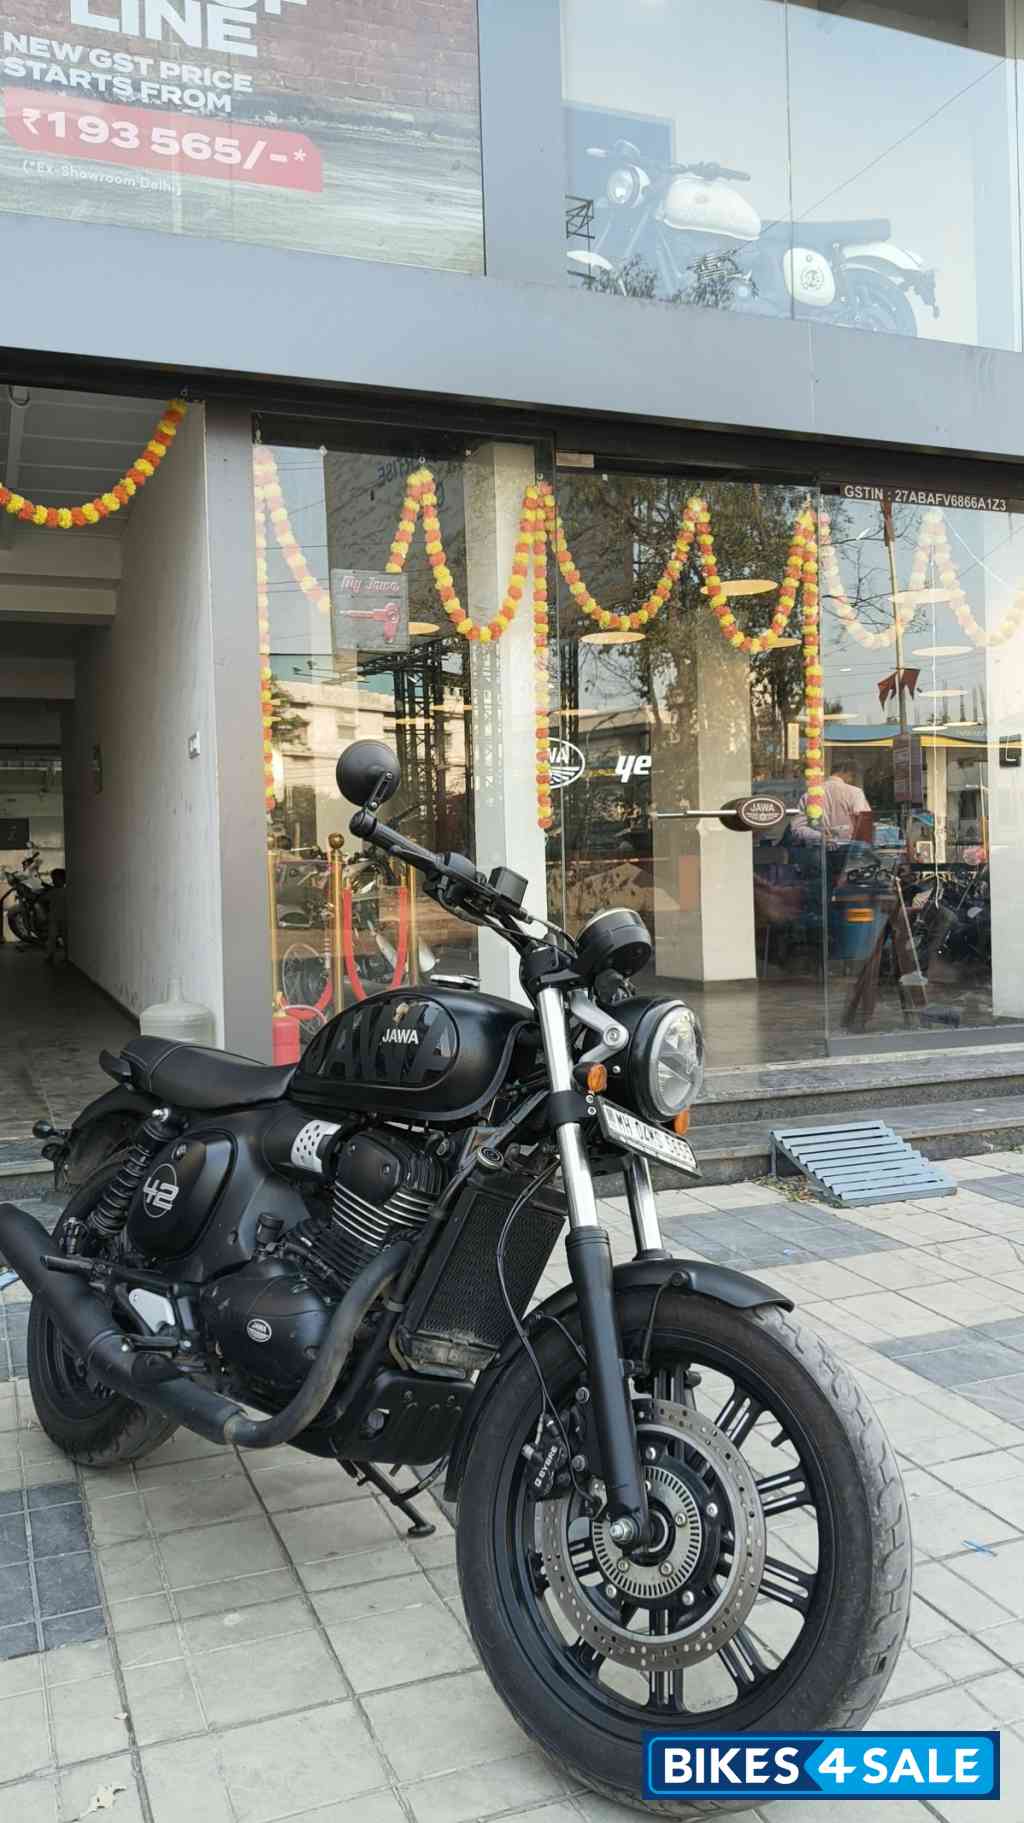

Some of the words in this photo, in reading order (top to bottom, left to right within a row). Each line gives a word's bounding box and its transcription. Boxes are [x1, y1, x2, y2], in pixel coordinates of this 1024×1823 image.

[70, 0, 258, 57] LINE
[2, 31, 84, 62] NEW
[88, 48, 155, 77] GST
[159, 60, 254, 94] PRICE
[2, 56, 133, 97] STARTS
[140, 80, 232, 113] FROM
[844, 485, 884, 499] GSTIN
[382, 1028, 419, 1044] JAWA
[143, 1177, 179, 1210] 42
